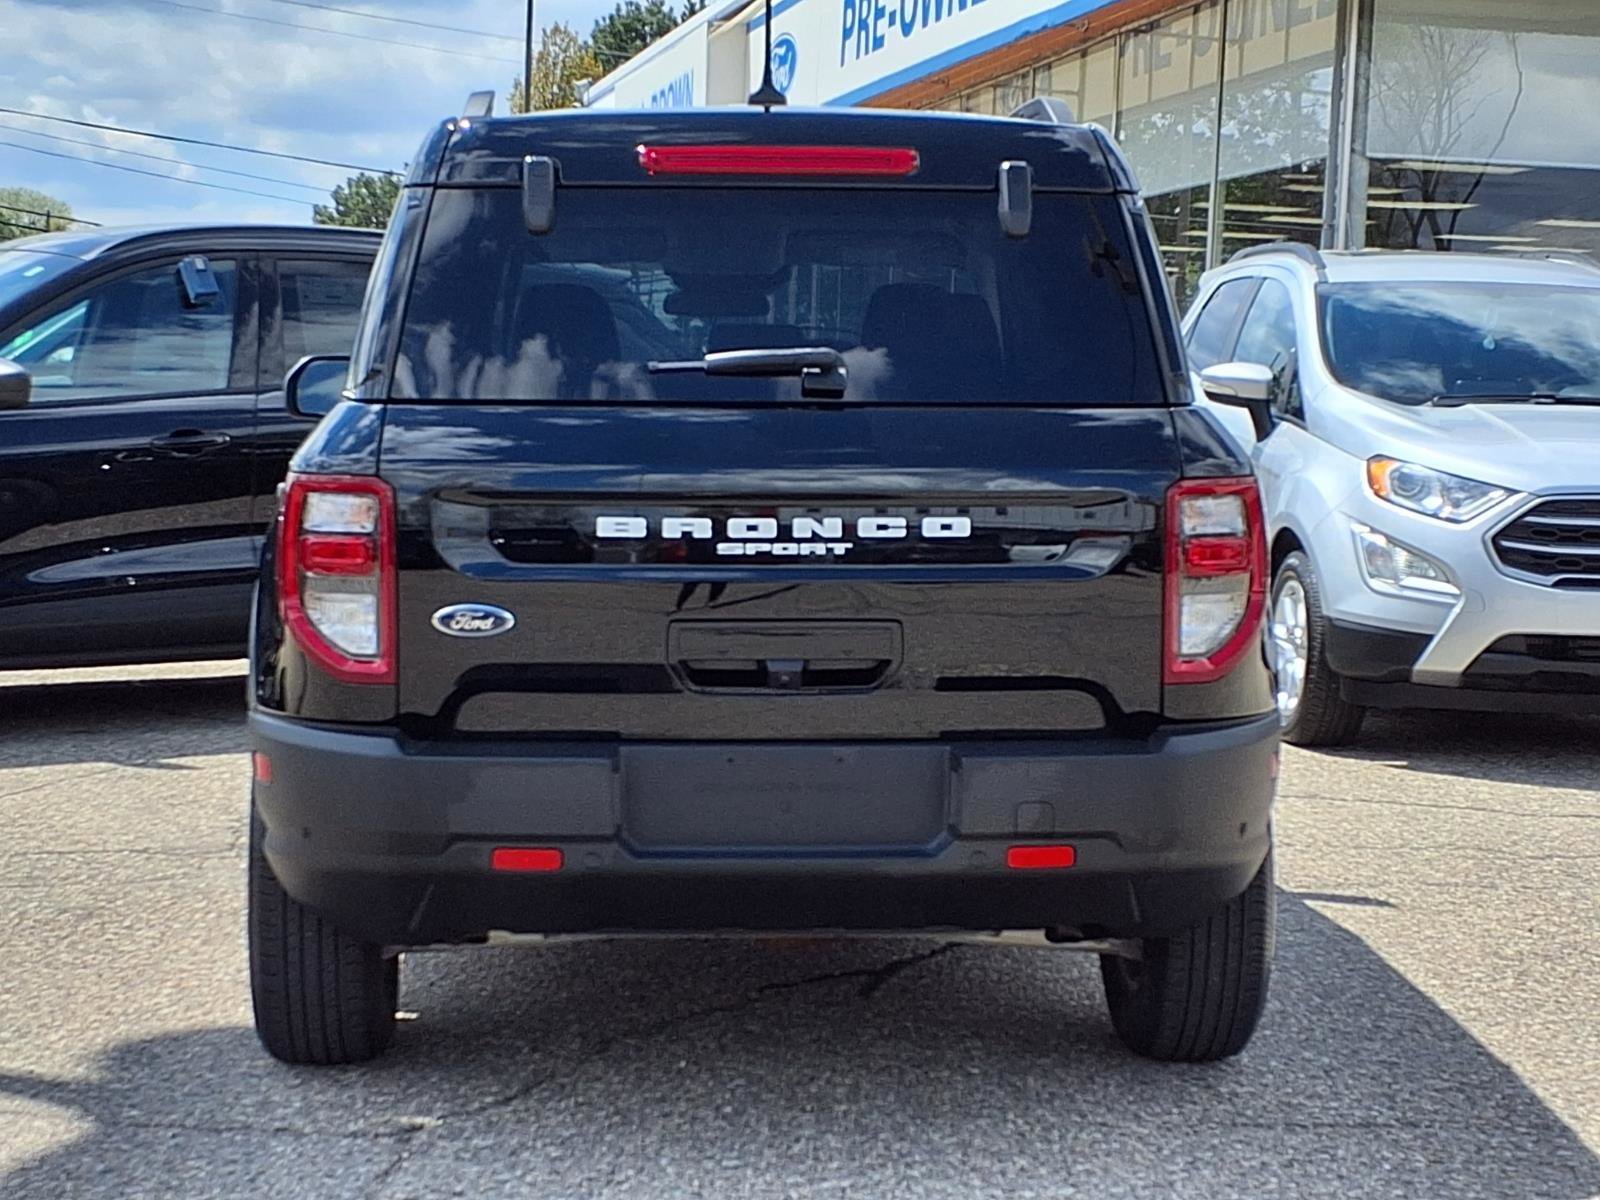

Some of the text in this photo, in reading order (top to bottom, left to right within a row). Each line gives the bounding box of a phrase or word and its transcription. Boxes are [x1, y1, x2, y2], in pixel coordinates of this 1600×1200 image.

[840, 0, 986, 68] PRE-O
[595, 516, 972, 539] BRONCO
[715, 542, 854, 556] SPORT
